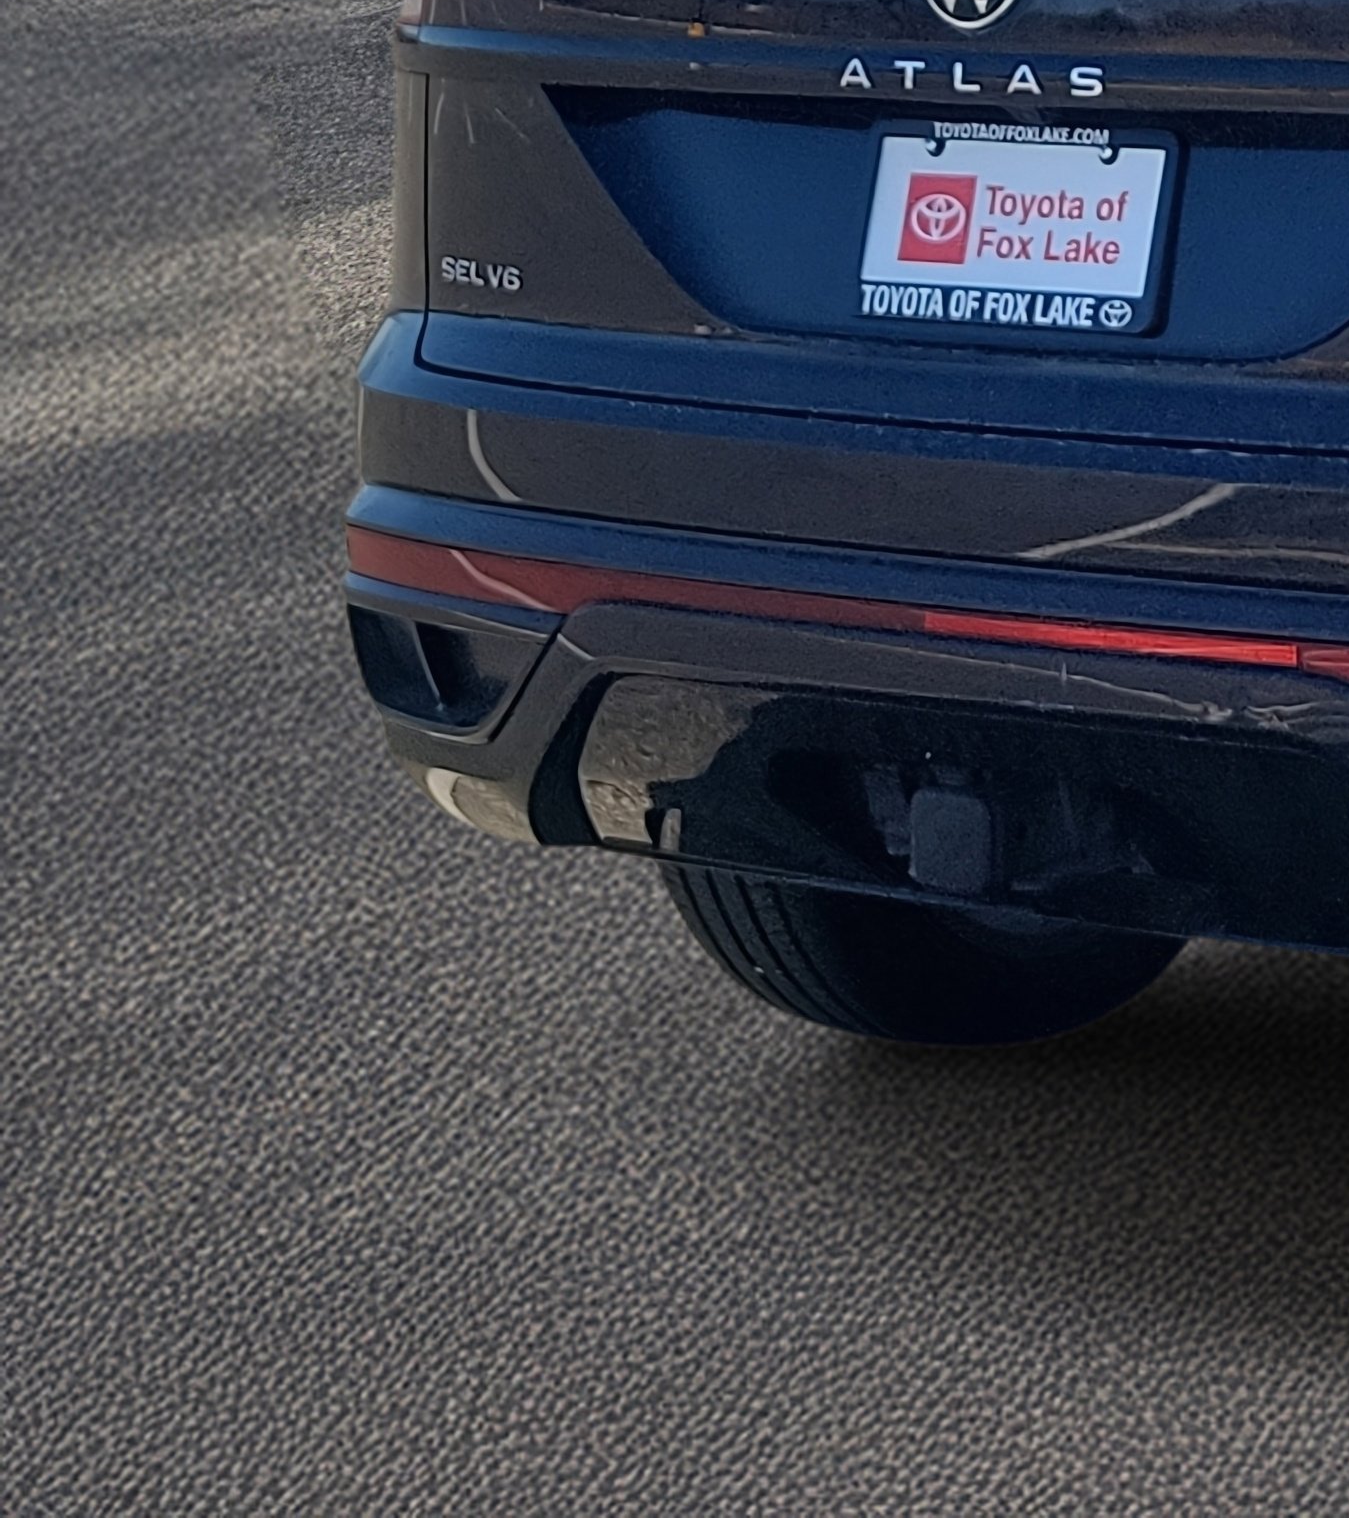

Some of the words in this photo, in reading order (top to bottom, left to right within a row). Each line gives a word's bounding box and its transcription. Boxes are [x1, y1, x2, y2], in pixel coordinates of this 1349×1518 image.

[840, 57, 1104, 98] ATLAS
[986, 186, 1084, 226] Toyota
[1095, 190, 1130, 223] of
[976, 228, 1033, 261] Fox
[1043, 231, 1121, 266] Lake
[441, 255, 485, 287] SEL
[486, 263, 522, 292] V6
[861, 284, 942, 318] TOYOTA
[948, 288, 980, 320] OF
[982, 291, 1029, 324] FOX
[1032, 295, 1097, 328] LAKE
